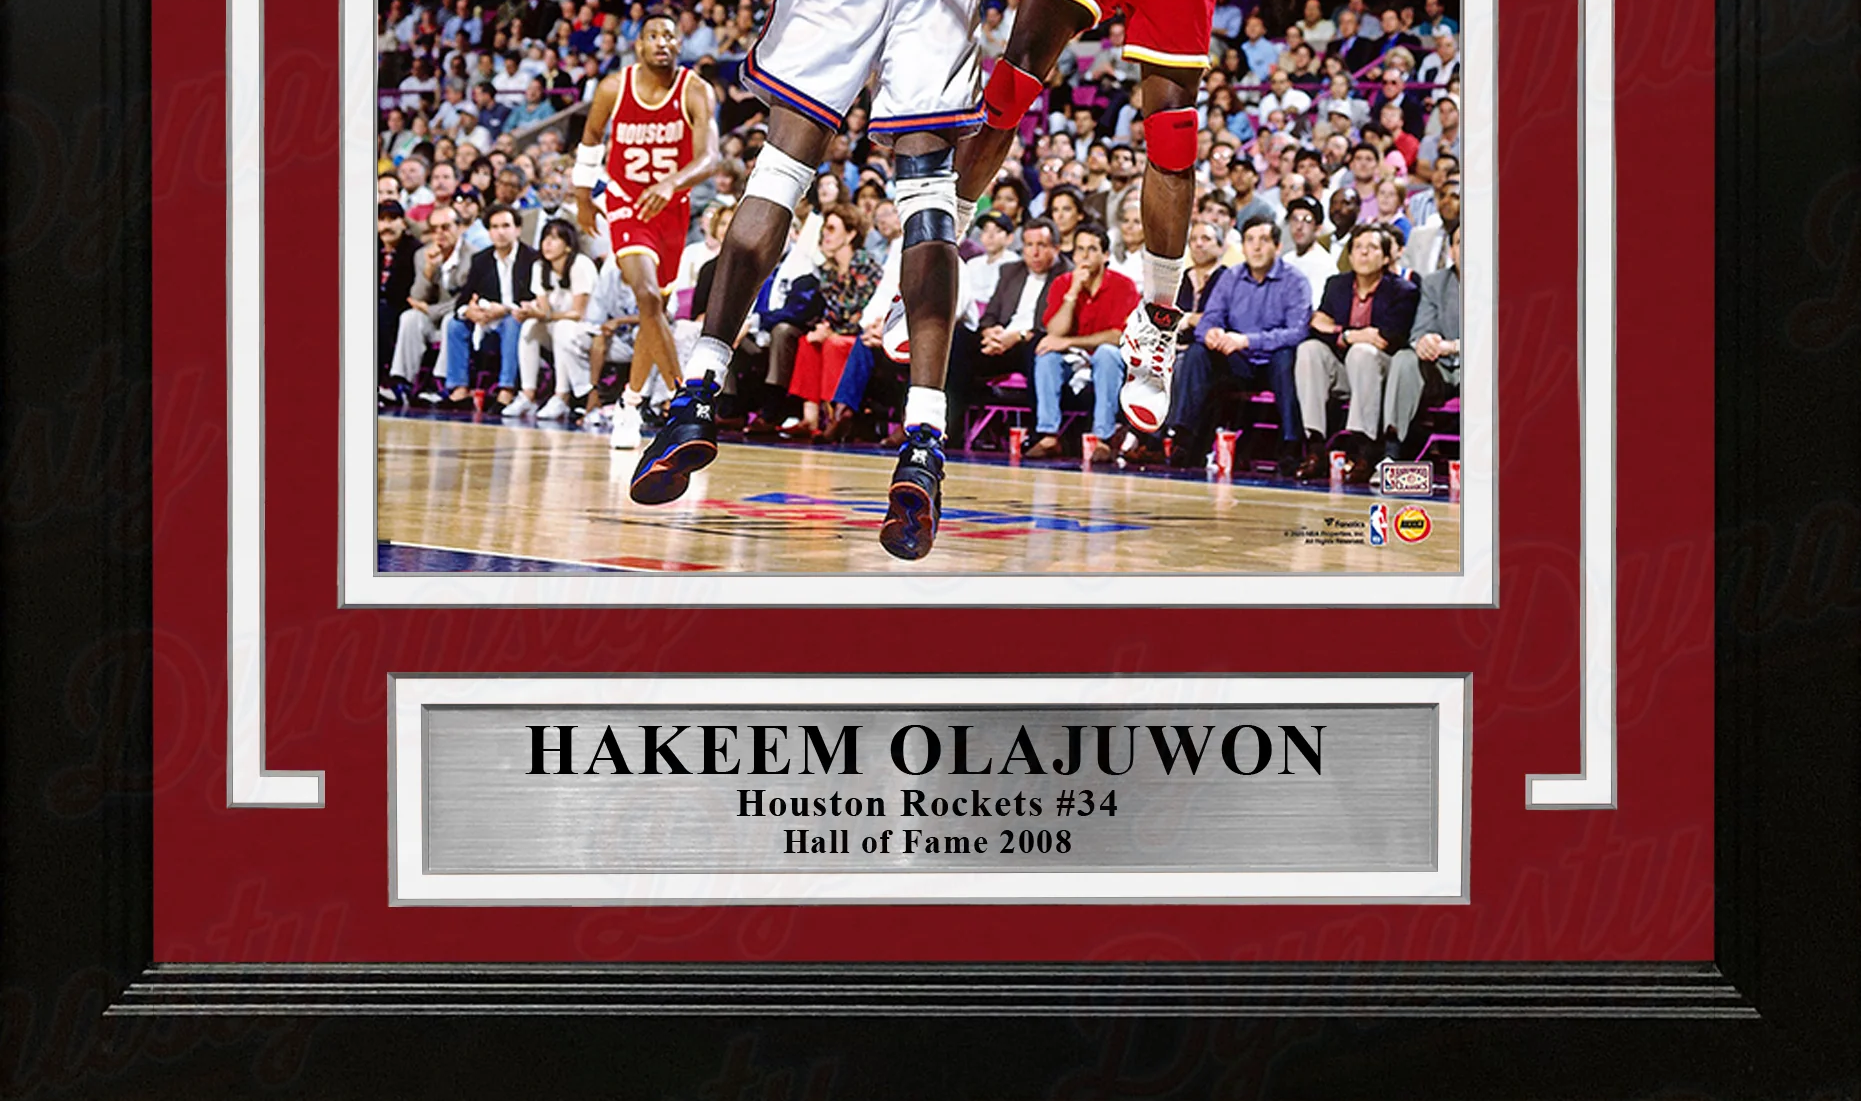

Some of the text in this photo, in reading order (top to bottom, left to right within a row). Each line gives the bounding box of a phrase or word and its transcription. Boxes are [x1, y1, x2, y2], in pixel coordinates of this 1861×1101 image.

[623, 147, 679, 183] 25
[526, 725, 1328, 775] HAKEEM OLAJUWON
[736, 790, 1118, 816] Houston Rockets #34
[784, 830, 1072, 854] Hall of Fame 2008
